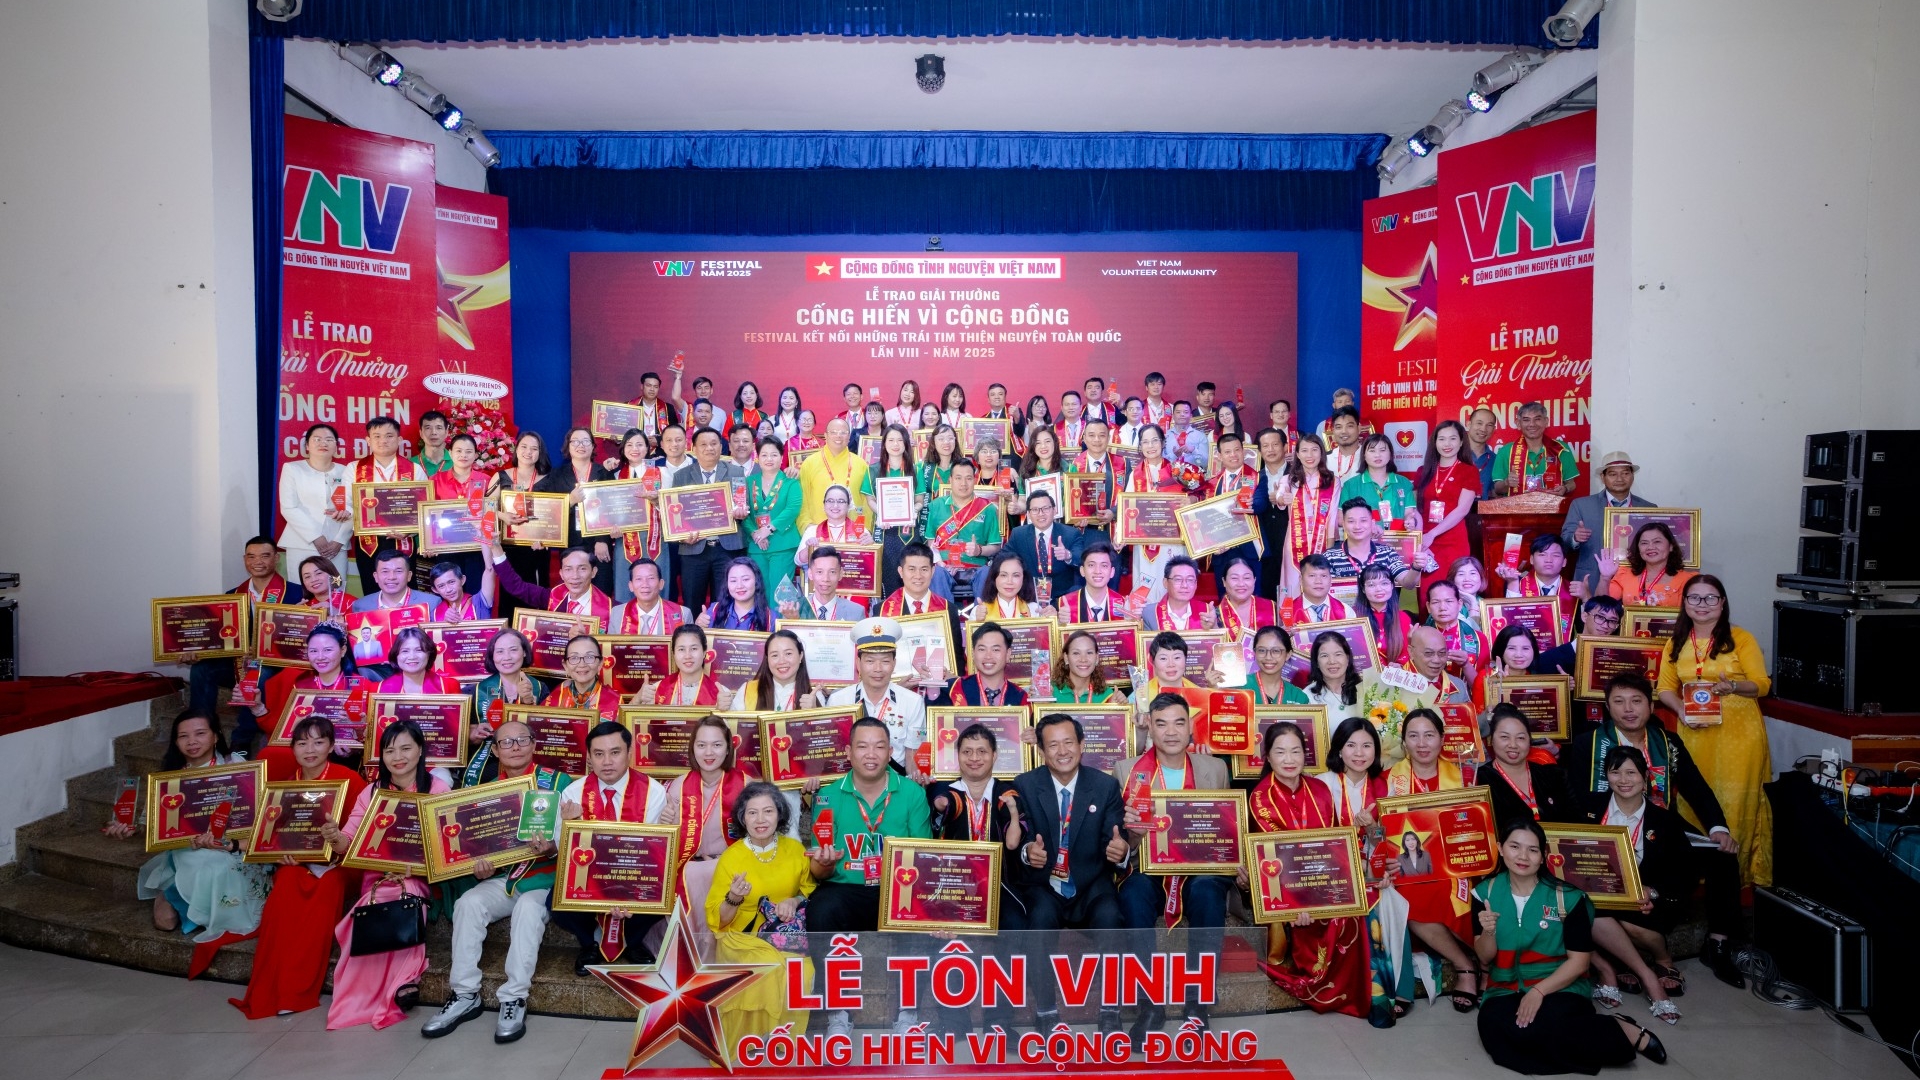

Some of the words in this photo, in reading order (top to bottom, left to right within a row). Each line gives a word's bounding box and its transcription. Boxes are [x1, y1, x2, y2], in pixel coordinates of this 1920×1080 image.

[1455, 163, 1596, 263] VNV
[1372, 213, 1400, 234] VNV
[283, 252, 293, 262] NG
[340, 259, 370, 273] NGUYỆN
[372, 262, 387, 276] VIỆT
[390, 267, 407, 277] NAM
[653, 261, 695, 276] VNV
[701, 261, 762, 269] FESTIVAL
[845, 259, 878, 277] CỘNG
[881, 259, 915, 275] ĐỒNG
[919, 259, 945, 275] TÌNH
[949, 259, 995, 277] NGUYỆN
[999, 259, 1024, 277] VIỆT
[1028, 262, 1056, 275] NAM
[1532, 258, 1558, 274] NGUYỆN
[1561, 254, 1575, 269] VIỆT
[866, 286, 880, 301] LỄ
[883, 290, 916, 301] TRAO
[920, 287, 946, 301] GIẢI
[949, 288, 1000, 301] THƯỞNG
[796, 302, 854, 326] CỐNG
[862, 302, 910, 325] HIẾN
[918, 302, 938, 325] VÌ
[946, 304, 1003, 329] CỘNG
[1010, 302, 1069, 326] ĐỒNG
[292, 311, 314, 339] LỄ
[320, 322, 372, 344] TRAO
[744, 332, 799, 343] FESTIVAL
[803, 329, 825, 343] KẾT
[828, 329, 850, 343] NỐI
[854, 330, 898, 343] NHỮNG
[901, 330, 930, 343] TRÁI
[933, 332, 956, 343] TIM
[959, 330, 995, 345] THIỆN
[999, 330, 1047, 345] NGUYỆN
[1051, 330, 1083, 343] TOÀN
[1087, 329, 1122, 344] QUỐC
[1490, 322, 1508, 351] LỄ
[1513, 325, 1559, 349] TRAO
[898, 348, 919, 358] VIII
[933, 345, 960, 358] NĂM
[964, 348, 995, 358] 2025
[280, 351, 310, 373] iải
[317, 348, 409, 387] Thưởng
[1398, 358, 1437, 377] FESTI
[1460, 359, 1503, 399] Giải
[1509, 350, 1592, 389] Thưởng
[479, 383, 502, 391] FRIENDS
[1377, 380, 1391, 395] TÔN
[1393, 381, 1411, 394] VINH
[1413, 378, 1423, 393] VÀ
[1425, 379, 1437, 392] TR
[280, 383, 336, 423] ỐNG
[347, 389, 410, 425] HIẾN
[1372, 396, 1391, 410] CỐNG
[1393, 394, 1410, 409] HIẾN
[1413, 394, 1420, 408] VÌ
[1422, 393, 1437, 410] CỘN
[267, 589, 280, 604] VN
[786, 934, 863, 1010] LỄ
[886, 940, 1027, 1009] TÔN
[1049, 953, 1216, 1007] VINH
[738, 1022, 852, 1068] CỐNG
[862, 1022, 956, 1067] HIẾN
[969, 1024, 1007, 1065] VÌ
[1018, 1023, 1132, 1073] CỘNG
[1143, 1016, 1259, 1064] ĐỒNG
